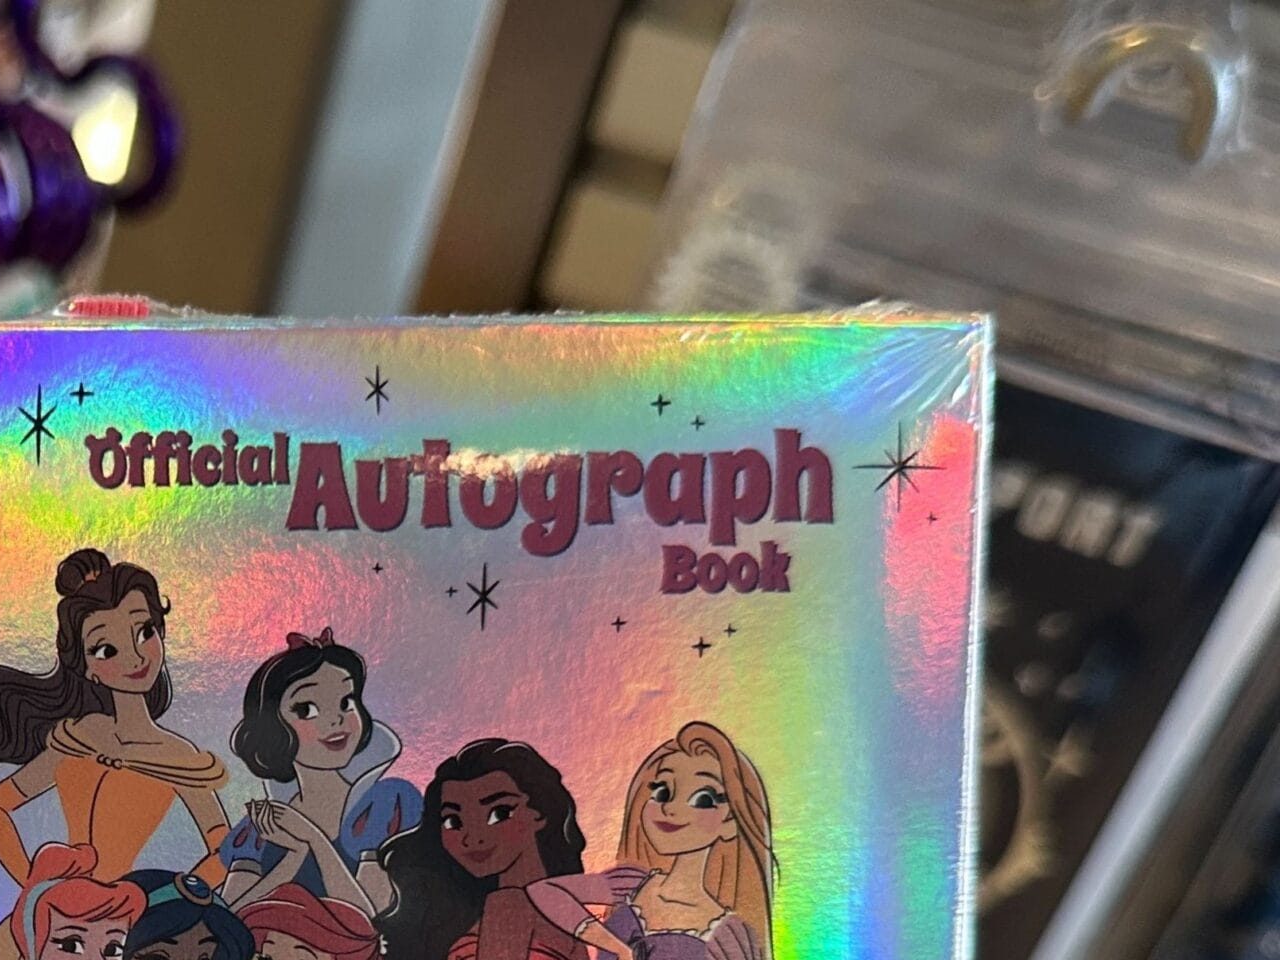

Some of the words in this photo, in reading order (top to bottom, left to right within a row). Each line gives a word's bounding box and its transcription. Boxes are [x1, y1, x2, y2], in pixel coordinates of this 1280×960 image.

[85, 427, 290, 489] Official
[285, 428, 834, 556] Autograph
[660, 540, 792, 594] Book
